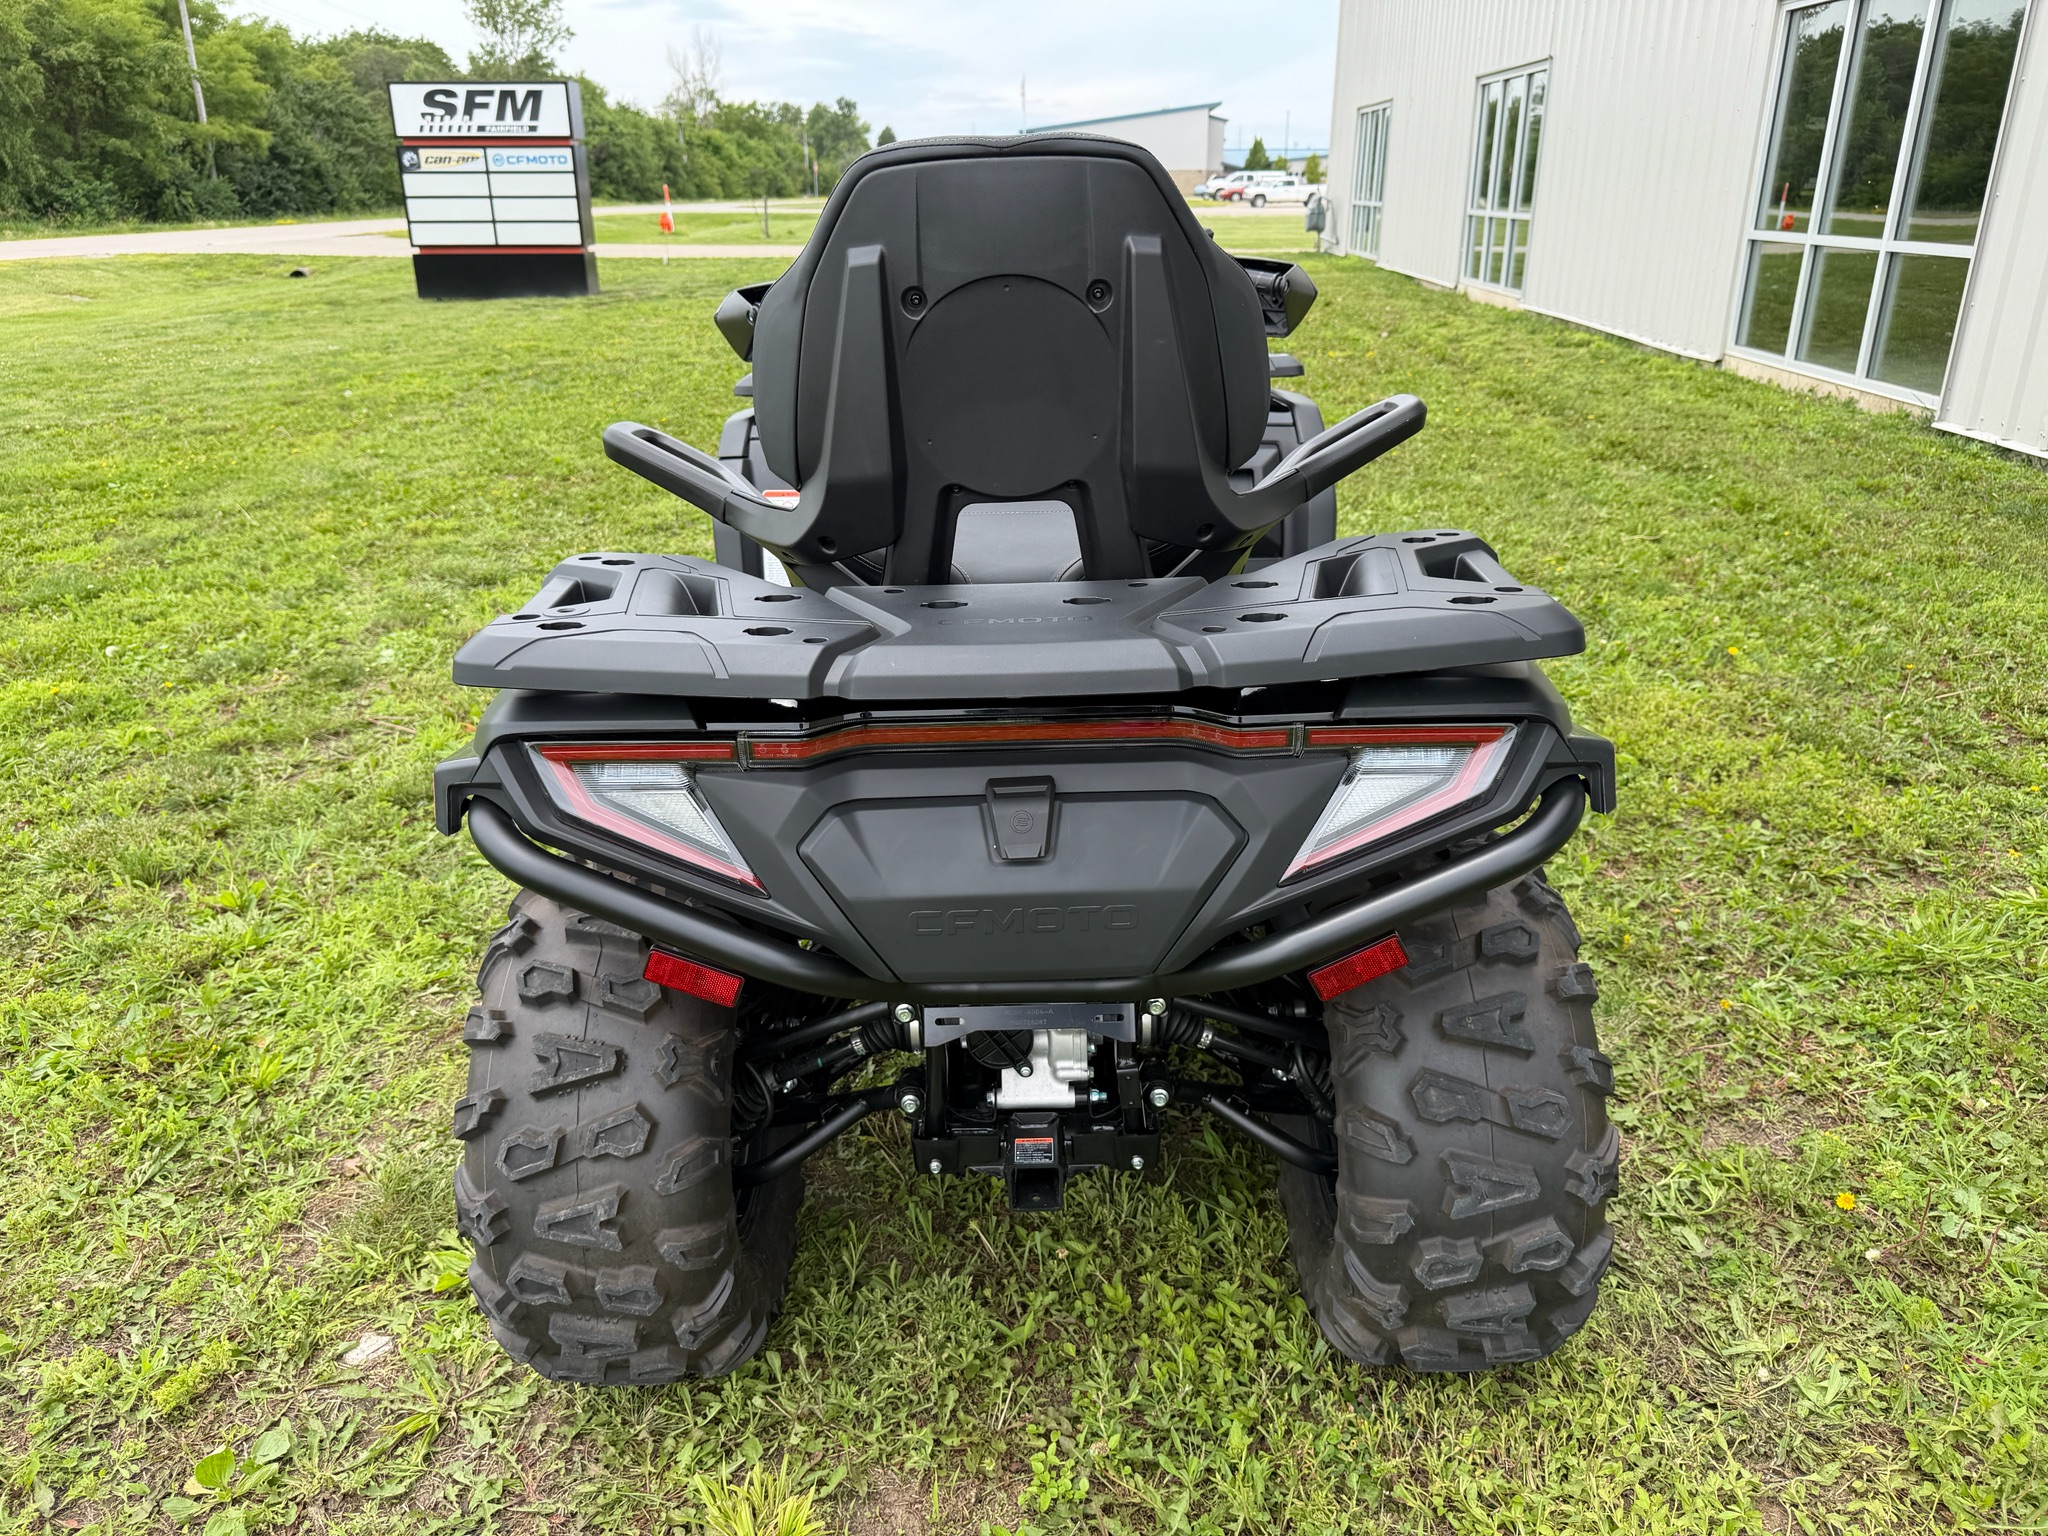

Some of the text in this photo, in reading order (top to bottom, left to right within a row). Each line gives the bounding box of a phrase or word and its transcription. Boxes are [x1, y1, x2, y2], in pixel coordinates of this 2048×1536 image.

[420, 88, 543, 122] SFM
[506, 155, 568, 165] CFMOTO
[938, 616, 1093, 626] CFMOTO
[908, 904, 1140, 936] CFMOTO
